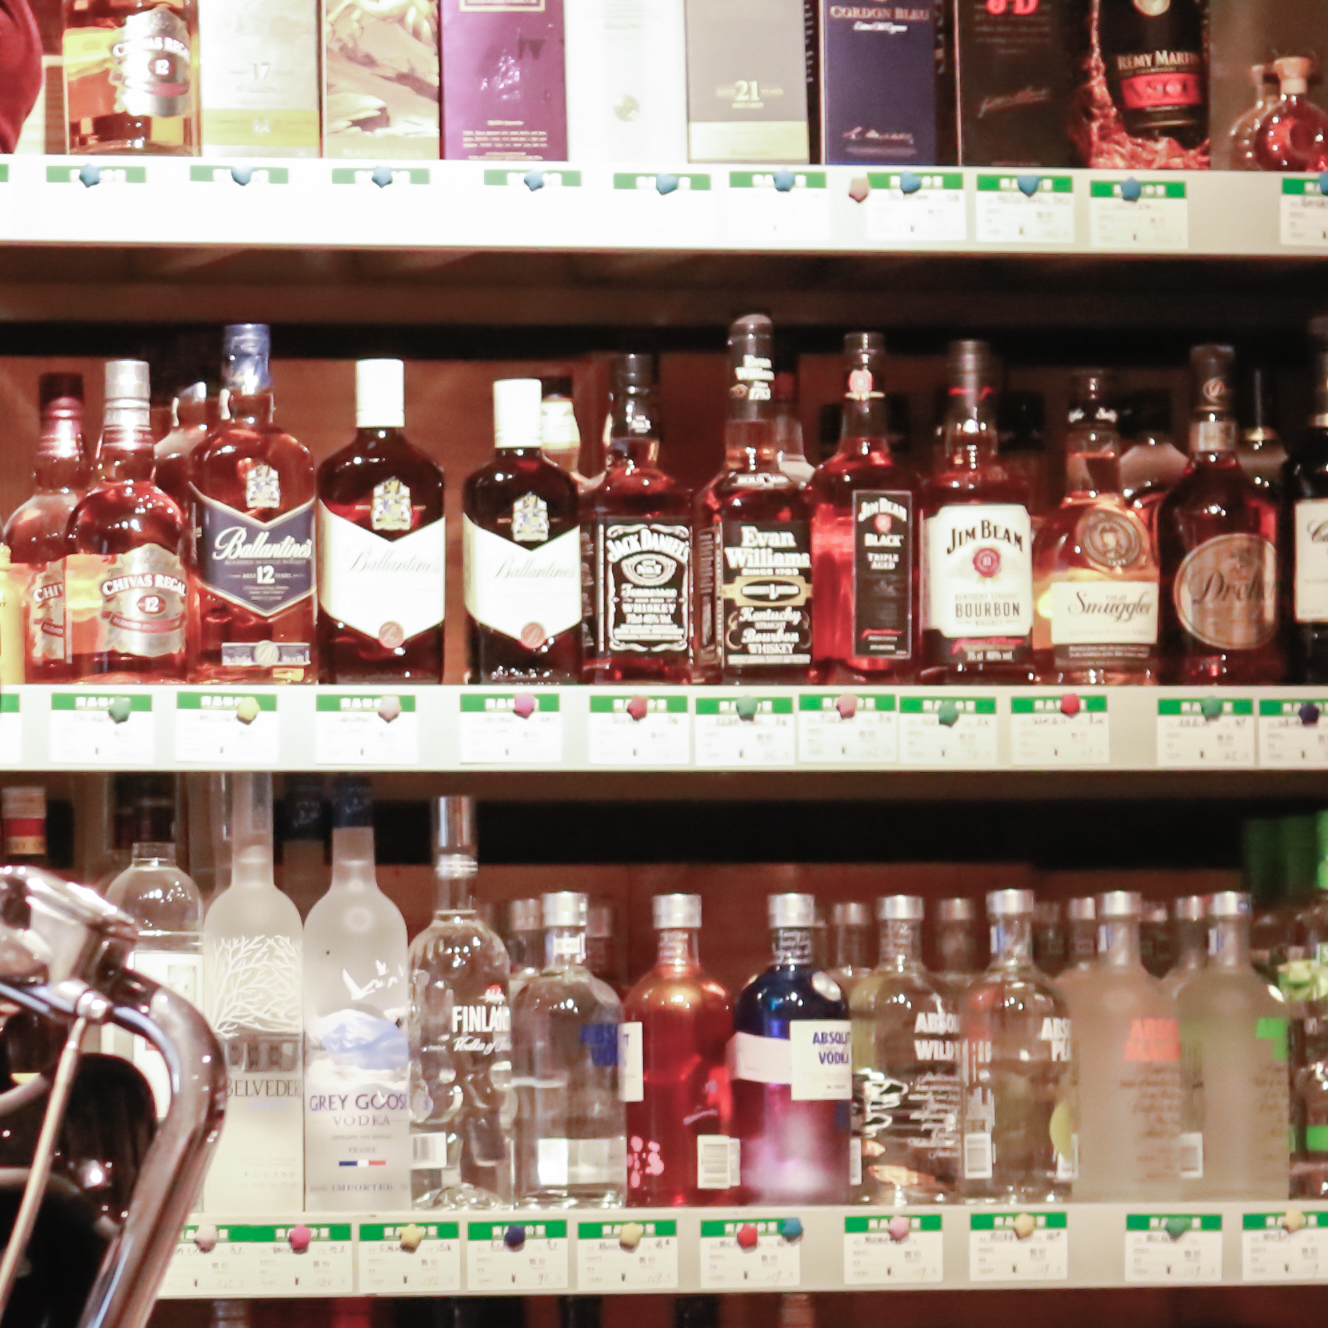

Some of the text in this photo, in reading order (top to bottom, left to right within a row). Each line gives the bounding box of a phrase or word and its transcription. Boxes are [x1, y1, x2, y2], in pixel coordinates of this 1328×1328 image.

[894, 6, 930, 20] BLEU
[252, 63, 270, 80] 17
[735, 80, 759, 101] 21
[858, 497, 907, 522] JIM BEAM
[212, 526, 312, 560] Ballantine's
[741, 526, 796, 546] Evan
[864, 533, 901, 547] BLACK
[946, 519, 1023, 553] JIM BEAM
[606, 533, 639, 563] JACK
[724, 547, 811, 568] Williams
[256, 566, 274, 584] 12
[102, 574, 186, 597] CHIVAS REGAL
[144, 596, 159, 612] 12
[956, 603, 1020, 617] BOURBON
[1068, 588, 1152, 621] Smuggler
[742, 629, 799, 645] Bourbon
[310, 1094, 346, 1111] GREY
[332, 1114, 391, 1127] VODKA
